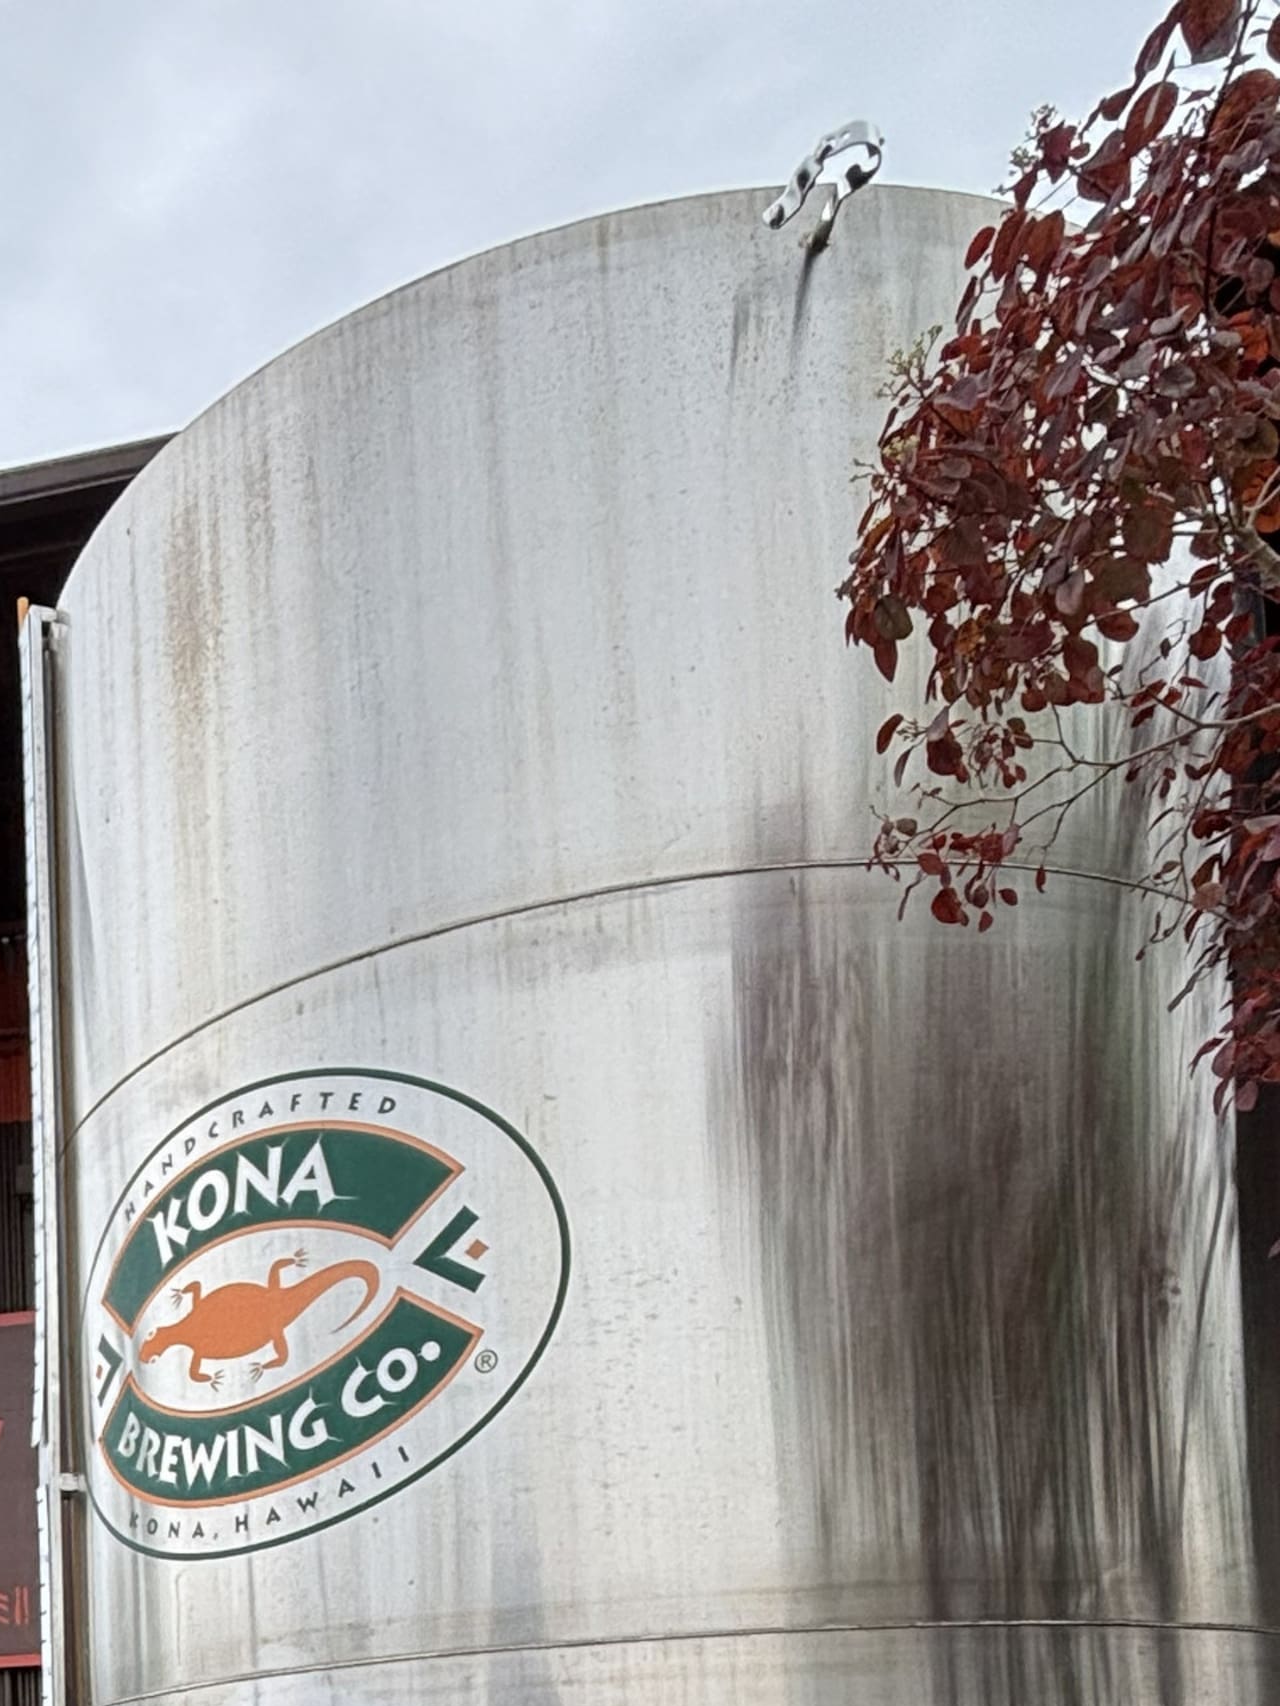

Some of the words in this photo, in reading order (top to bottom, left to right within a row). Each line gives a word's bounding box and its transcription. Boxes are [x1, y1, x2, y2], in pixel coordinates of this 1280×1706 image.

[124, 1091, 398, 1223] HANDCRAFTED
[147, 1133, 357, 1267] KONA
[117, 1386, 341, 1492] BREWING
[129, 1510, 220, 1541] KONA,
[234, 1445, 411, 1534] HAWAII
